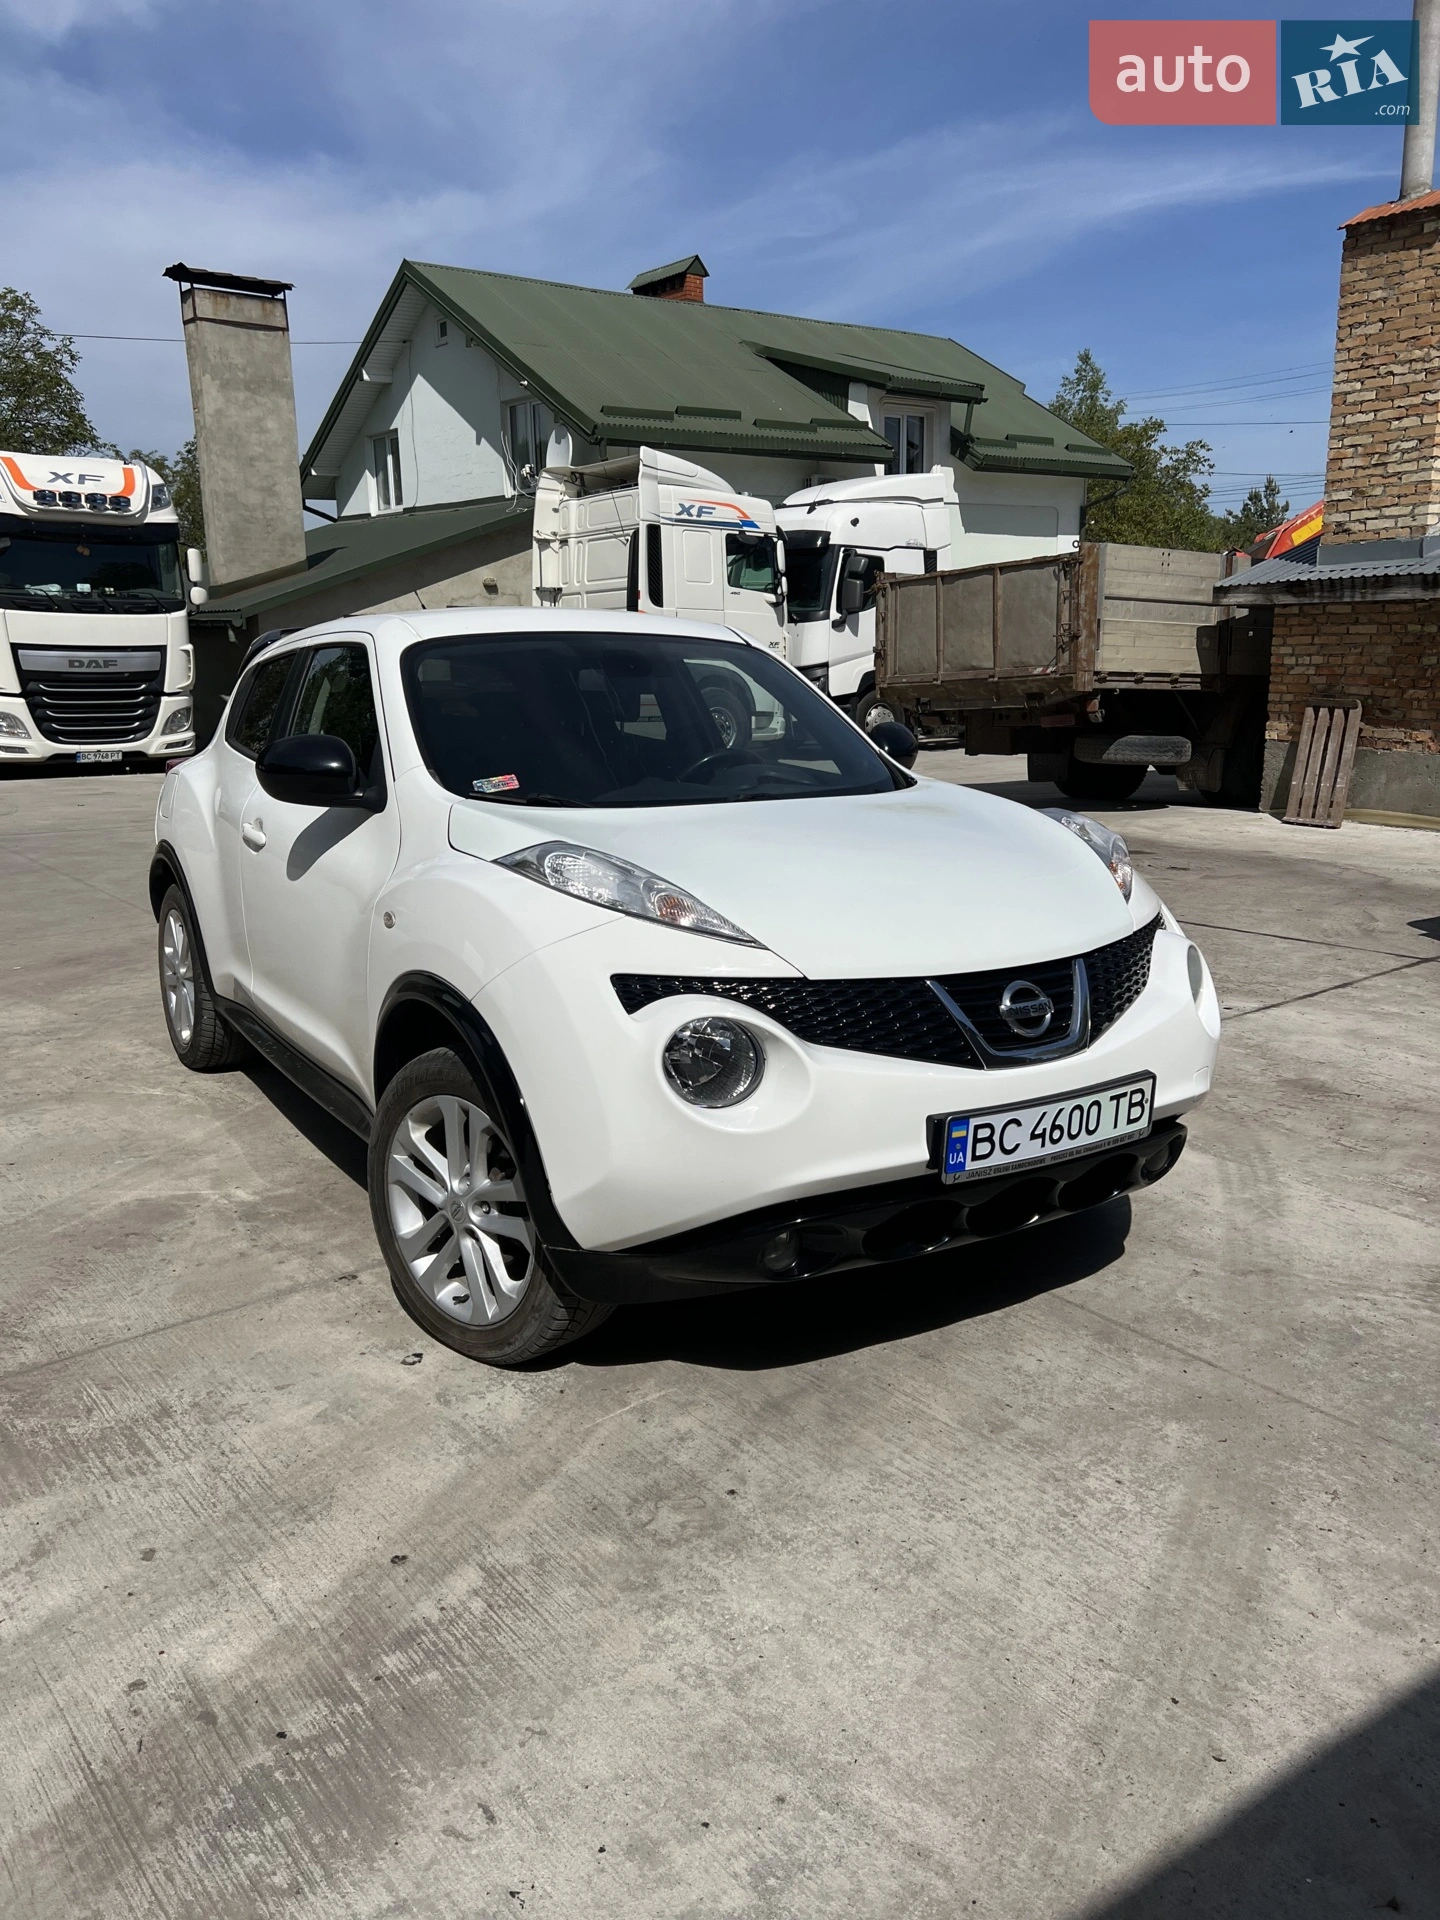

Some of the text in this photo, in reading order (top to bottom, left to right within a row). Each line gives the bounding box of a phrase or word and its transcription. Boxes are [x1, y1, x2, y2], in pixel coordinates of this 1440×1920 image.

[46, 471, 105, 486] XF
[675, 502, 717, 519] XF
[68, 659, 119, 669] DAF
[81, 753, 92, 761] BC
[93, 752, 110, 760] 9768
[110, 752, 121, 760] PT
[1008, 1001, 1052, 1016] NISSAN
[970, 1087, 1146, 1162] BC 4600 TB
[949, 1151, 965, 1165] UA
[965, 1168, 993, 1180] JANISZ
